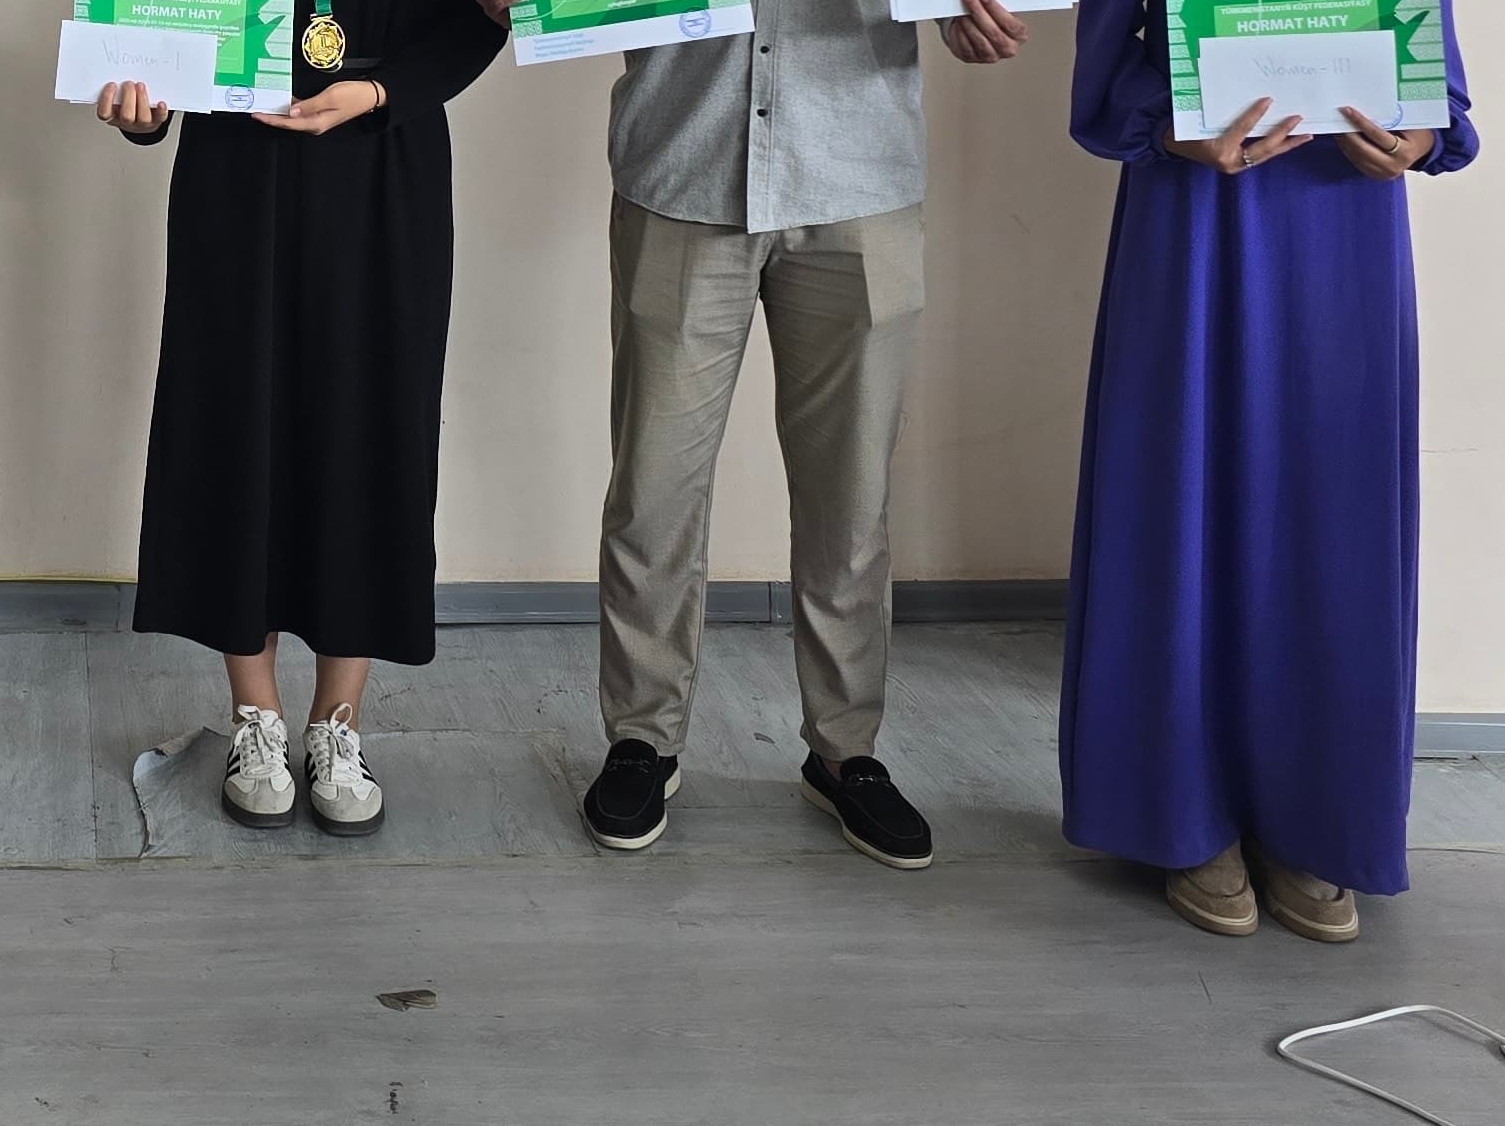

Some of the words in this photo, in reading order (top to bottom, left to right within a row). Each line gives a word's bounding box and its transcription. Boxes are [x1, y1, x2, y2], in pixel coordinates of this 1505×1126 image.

[132, 4, 186, 18] HORMAT
[188, 8, 222, 20] HATY
[1237, 17, 1303, 33] HORMAT
[1307, 14, 1348, 28] HATY
